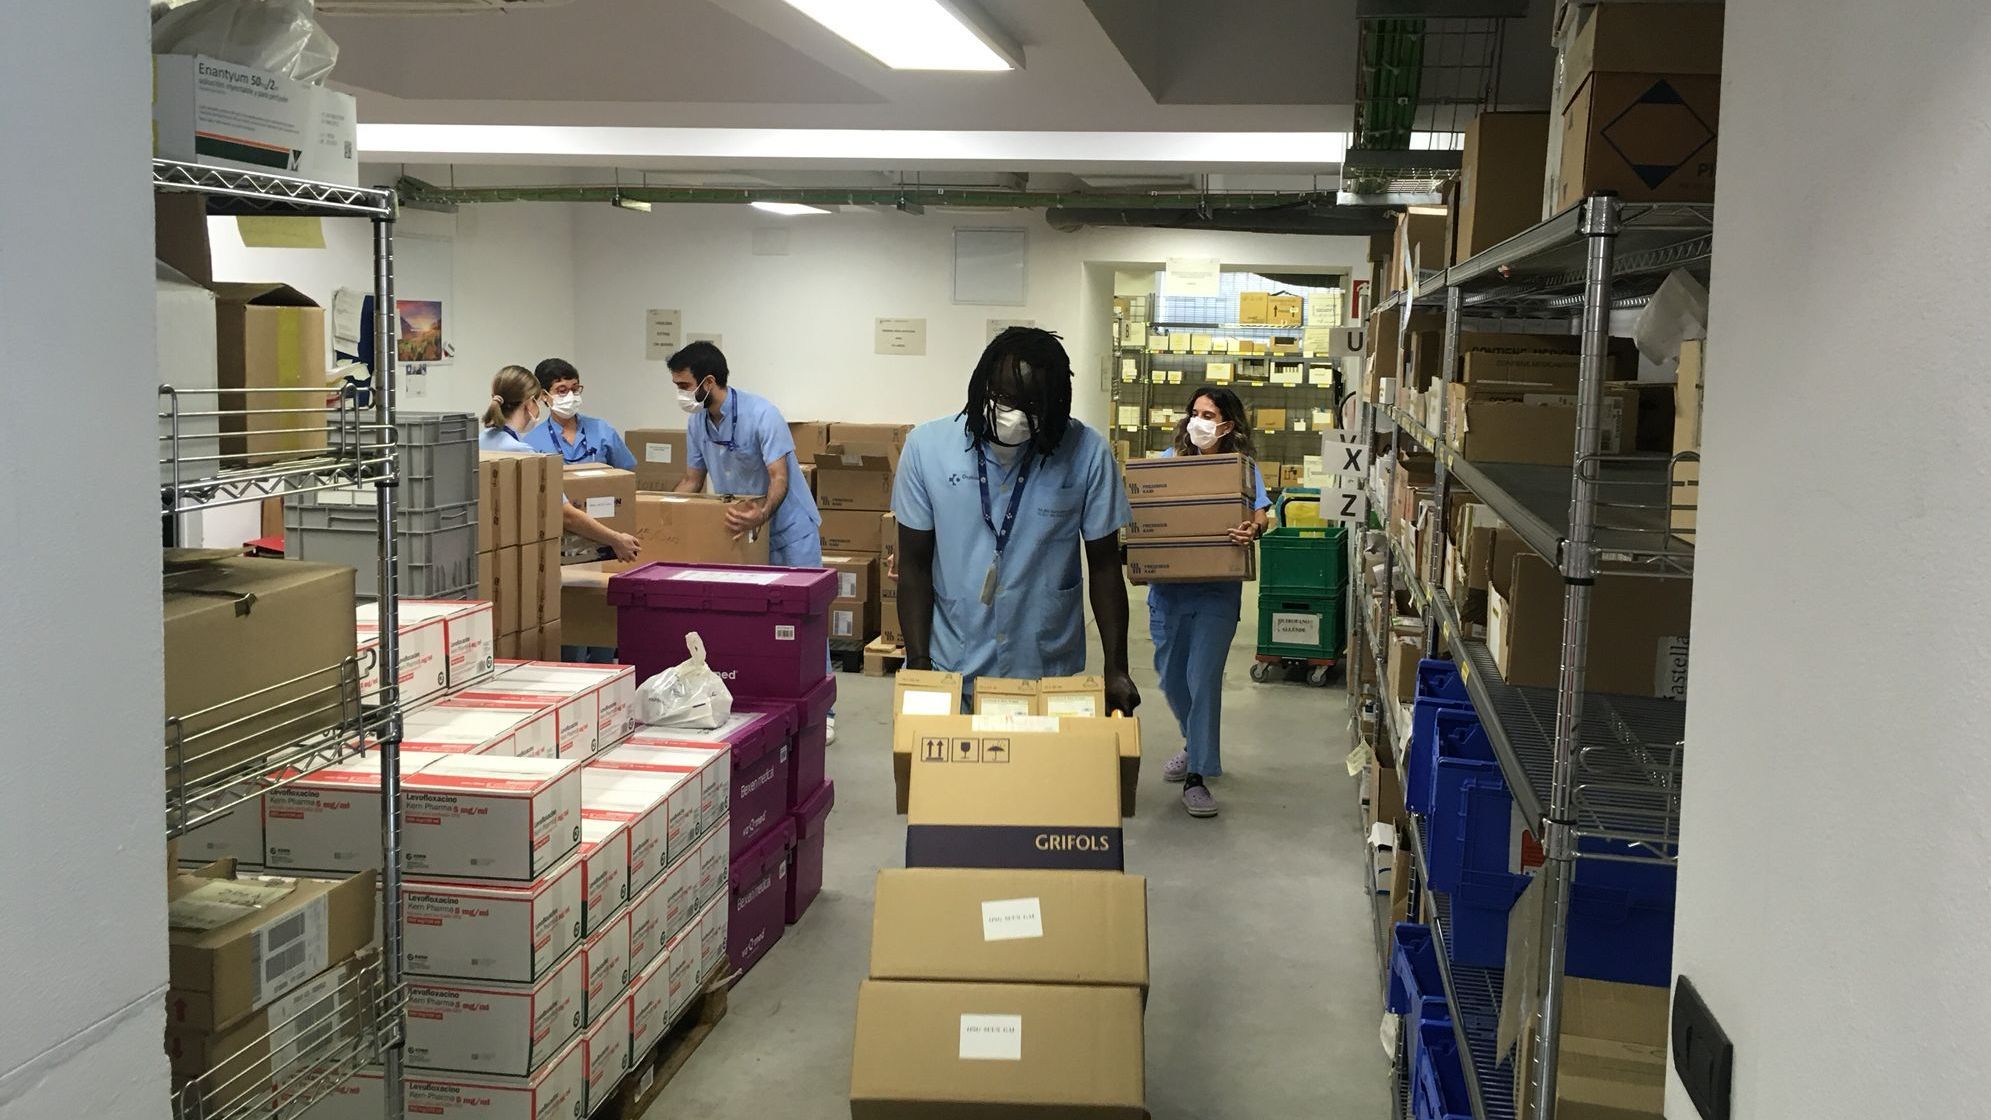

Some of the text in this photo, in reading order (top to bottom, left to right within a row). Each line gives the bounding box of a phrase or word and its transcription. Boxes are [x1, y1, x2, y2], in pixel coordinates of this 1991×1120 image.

[199, 63, 248, 85] Enantyum
[1347, 331, 1364, 351] U
[1342, 448, 1363, 471] X
[1340, 493, 1357, 517] Z
[406, 793, 457, 803] Levofloxacino
[424, 802, 452, 812] Pharma
[460, 805, 489, 815] mg/ml
[1035, 834, 1109, 850] GRIFOLS
[408, 893, 459, 904] Levofloxacino
[407, 902, 425, 910] Kern
[426, 903, 453, 913] Pharma
[462, 907, 490, 917] mg/ml
[462, 1002, 490, 1011] mg/ml
[409, 1082, 460, 1093] Levofloxacino
